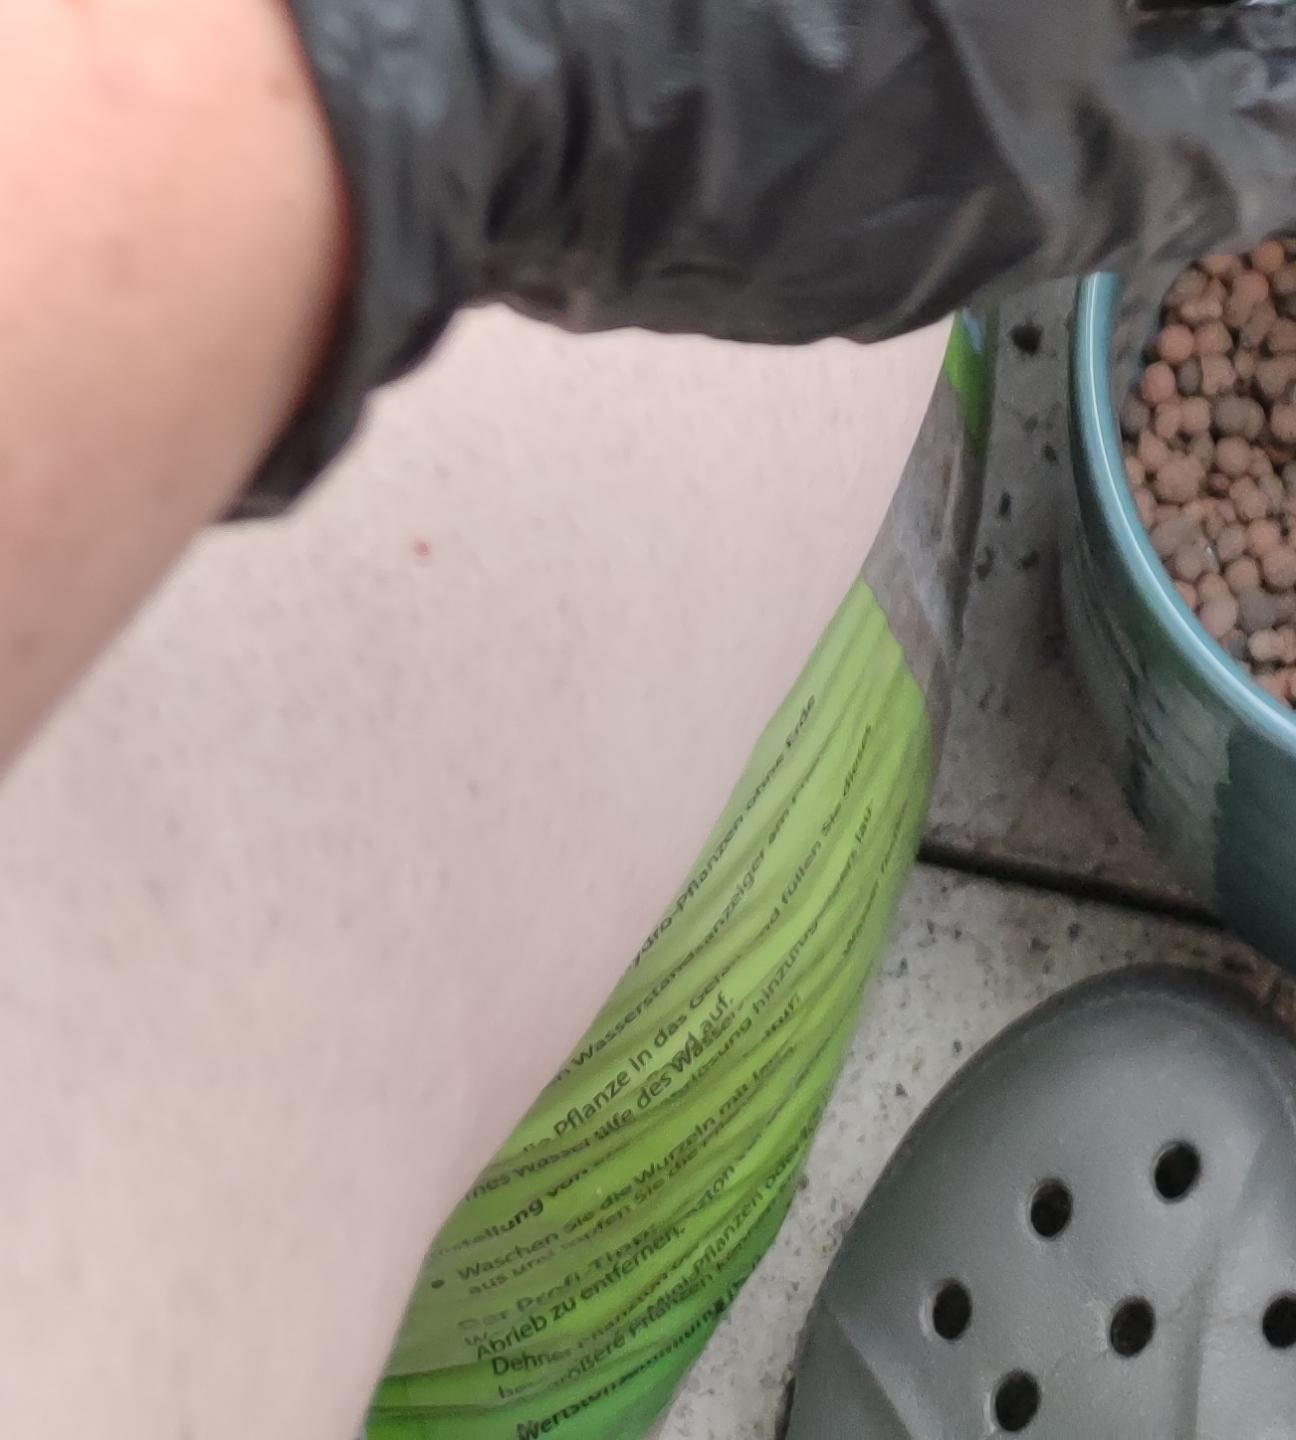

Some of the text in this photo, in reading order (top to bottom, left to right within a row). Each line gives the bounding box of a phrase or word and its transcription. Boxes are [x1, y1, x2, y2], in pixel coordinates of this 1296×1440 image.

[552, 1068, 632, 1138] Pflanze
[653, 1012, 688, 1050] das
[456, 1231, 560, 1281] Waschen
[476, 1313, 548, 1361] Abrieb
[550, 1296, 577, 1322] zu
